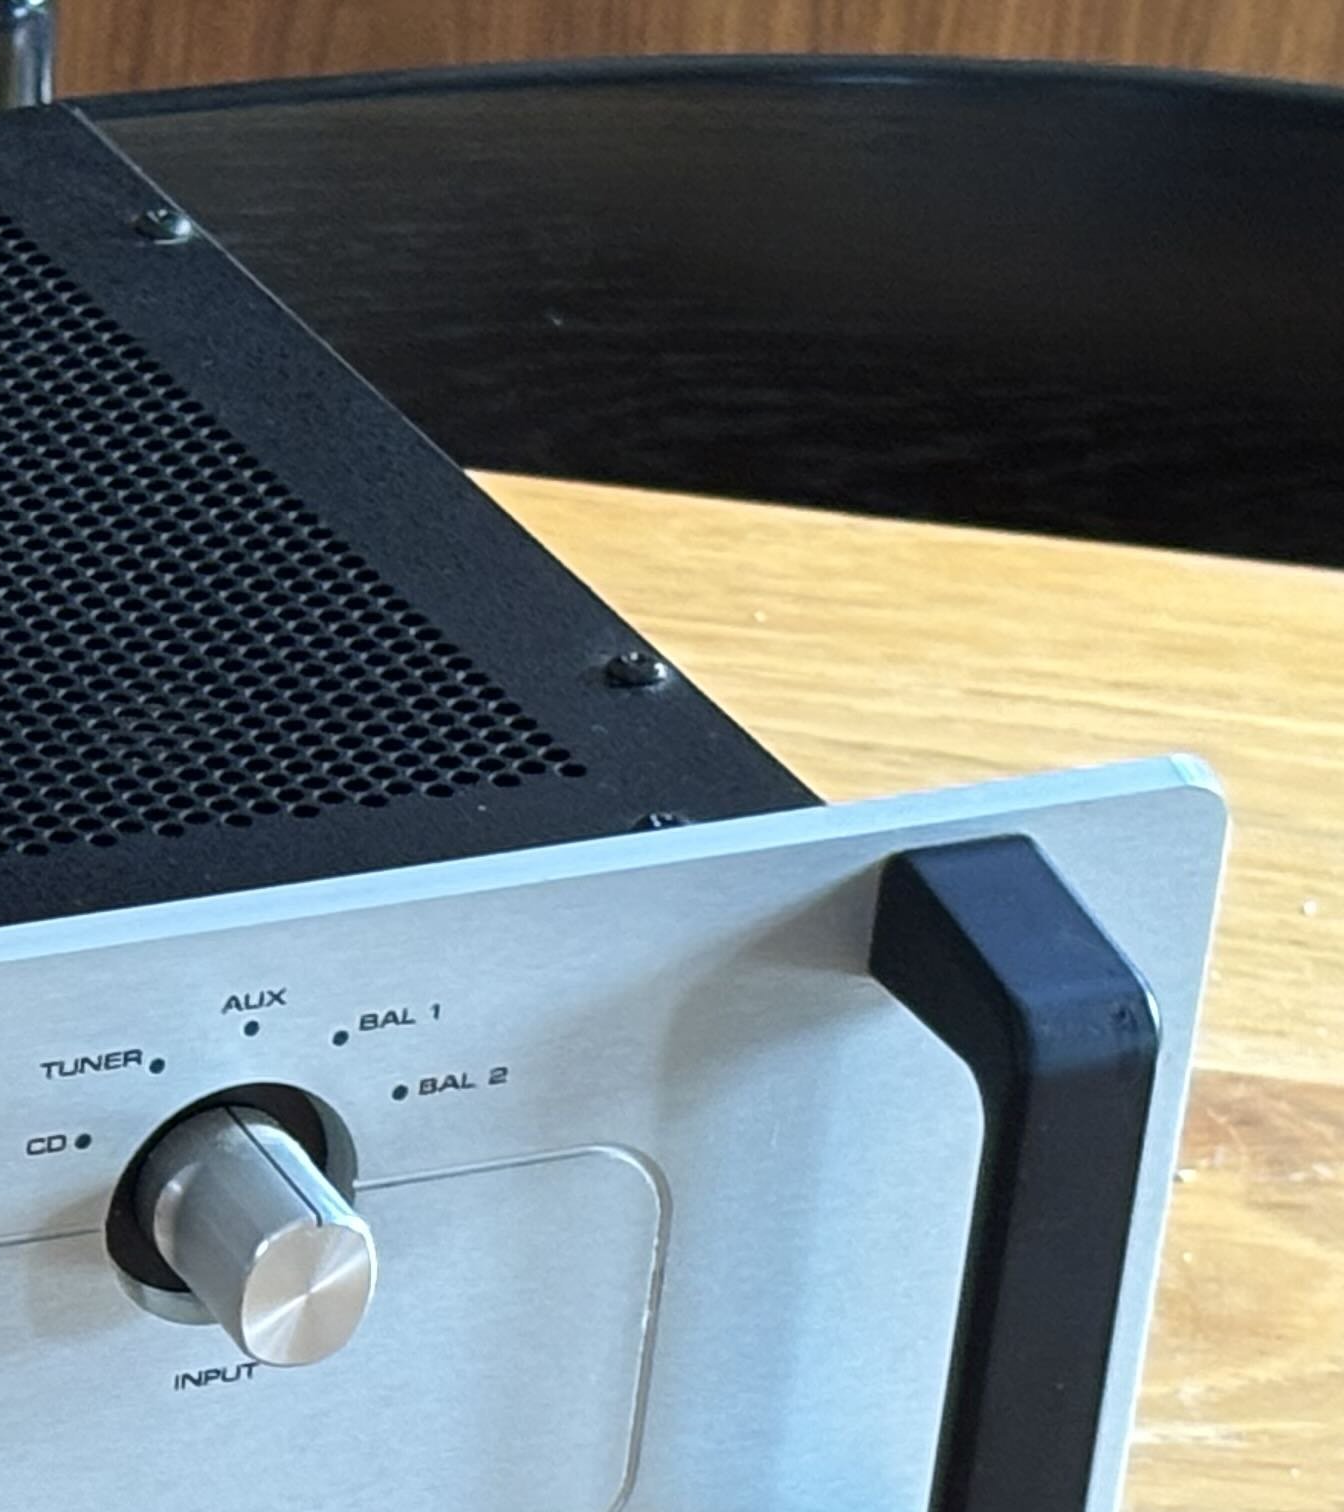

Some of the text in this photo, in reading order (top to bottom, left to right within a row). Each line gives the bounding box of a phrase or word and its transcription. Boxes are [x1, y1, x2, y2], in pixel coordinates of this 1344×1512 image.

[221, 987, 288, 1015] AUX
[358, 1003, 442, 1032] BAL 1
[40, 1048, 143, 1080] TUNER
[417, 1066, 509, 1096] BAL 2
[26, 1134, 67, 1156] CD
[174, 1361, 260, 1391] INPUT
